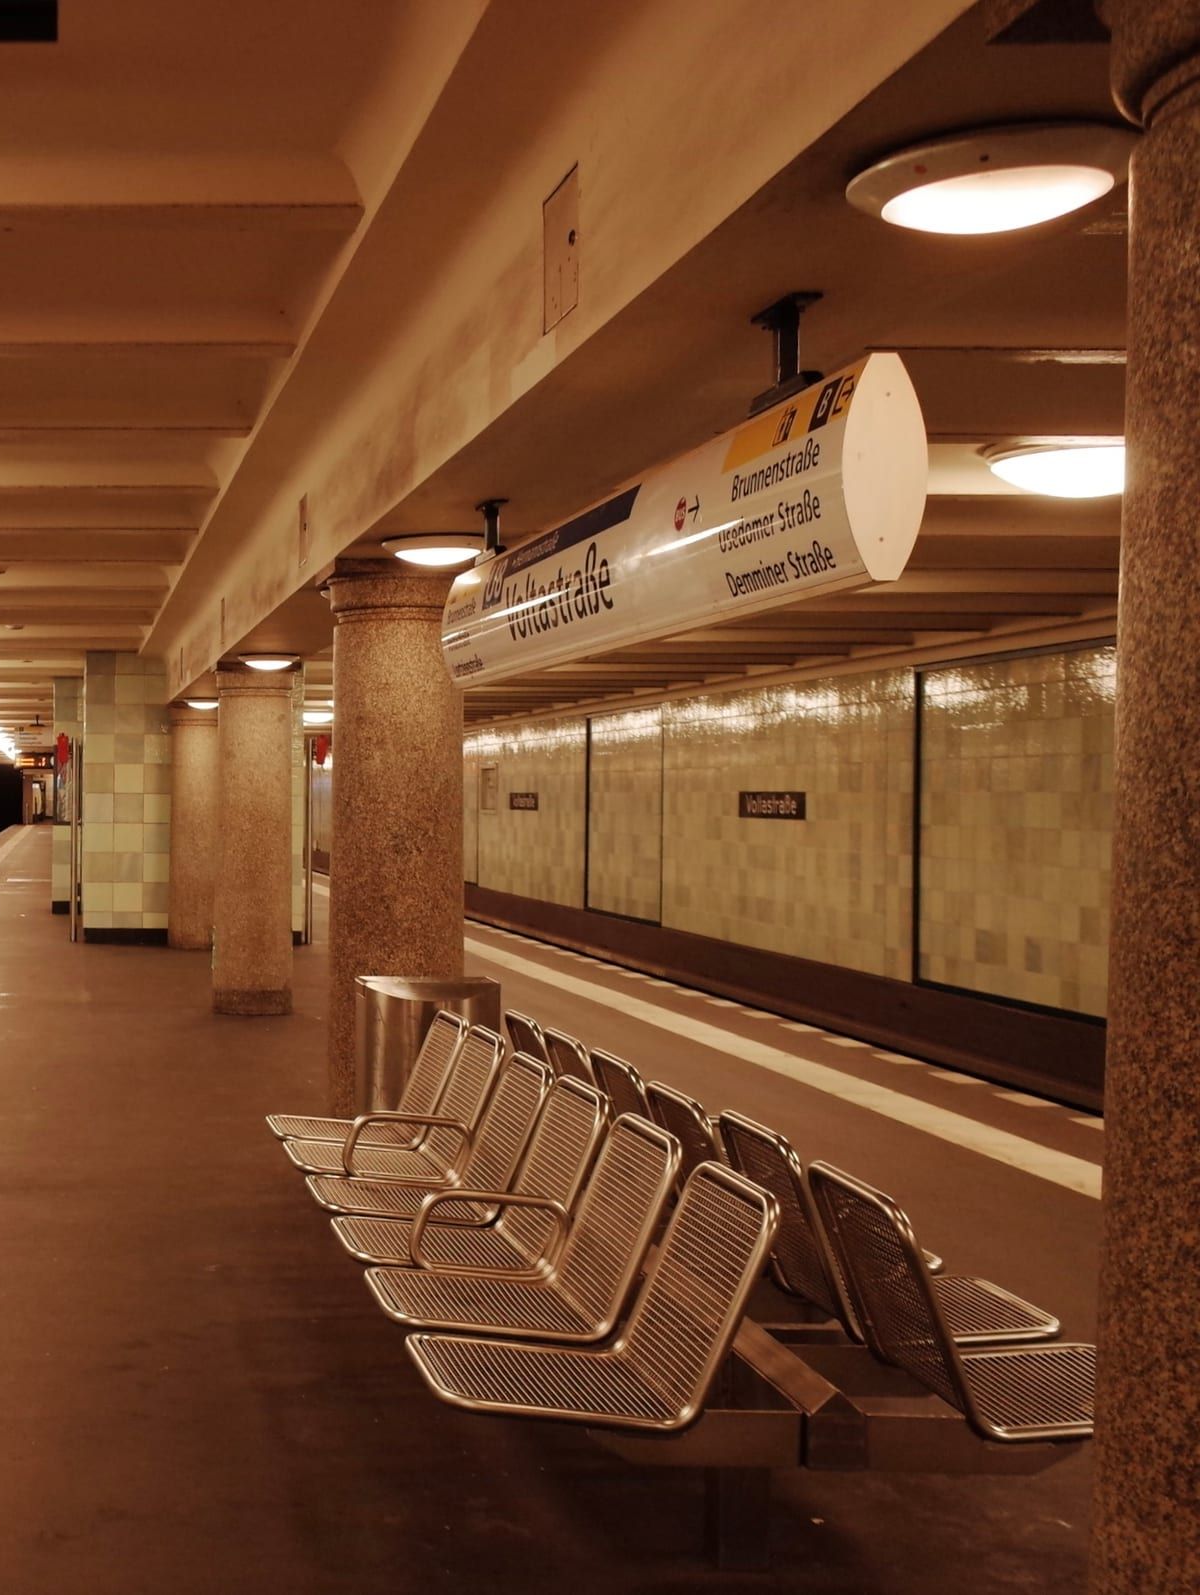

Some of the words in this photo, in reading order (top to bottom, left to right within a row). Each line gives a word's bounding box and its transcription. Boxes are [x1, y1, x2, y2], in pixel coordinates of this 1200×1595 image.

[816, 387, 834, 418] B
[731, 437, 821, 502] Brunnenstraße
[718, 513, 775, 553] Usedomer
[777, 489, 822, 533] Straße
[506, 541, 614, 642] Voltastraße
[725, 560, 787, 598] Demminer
[786, 540, 837, 580] Straße
[744, 794, 798, 815] Voltastraße
